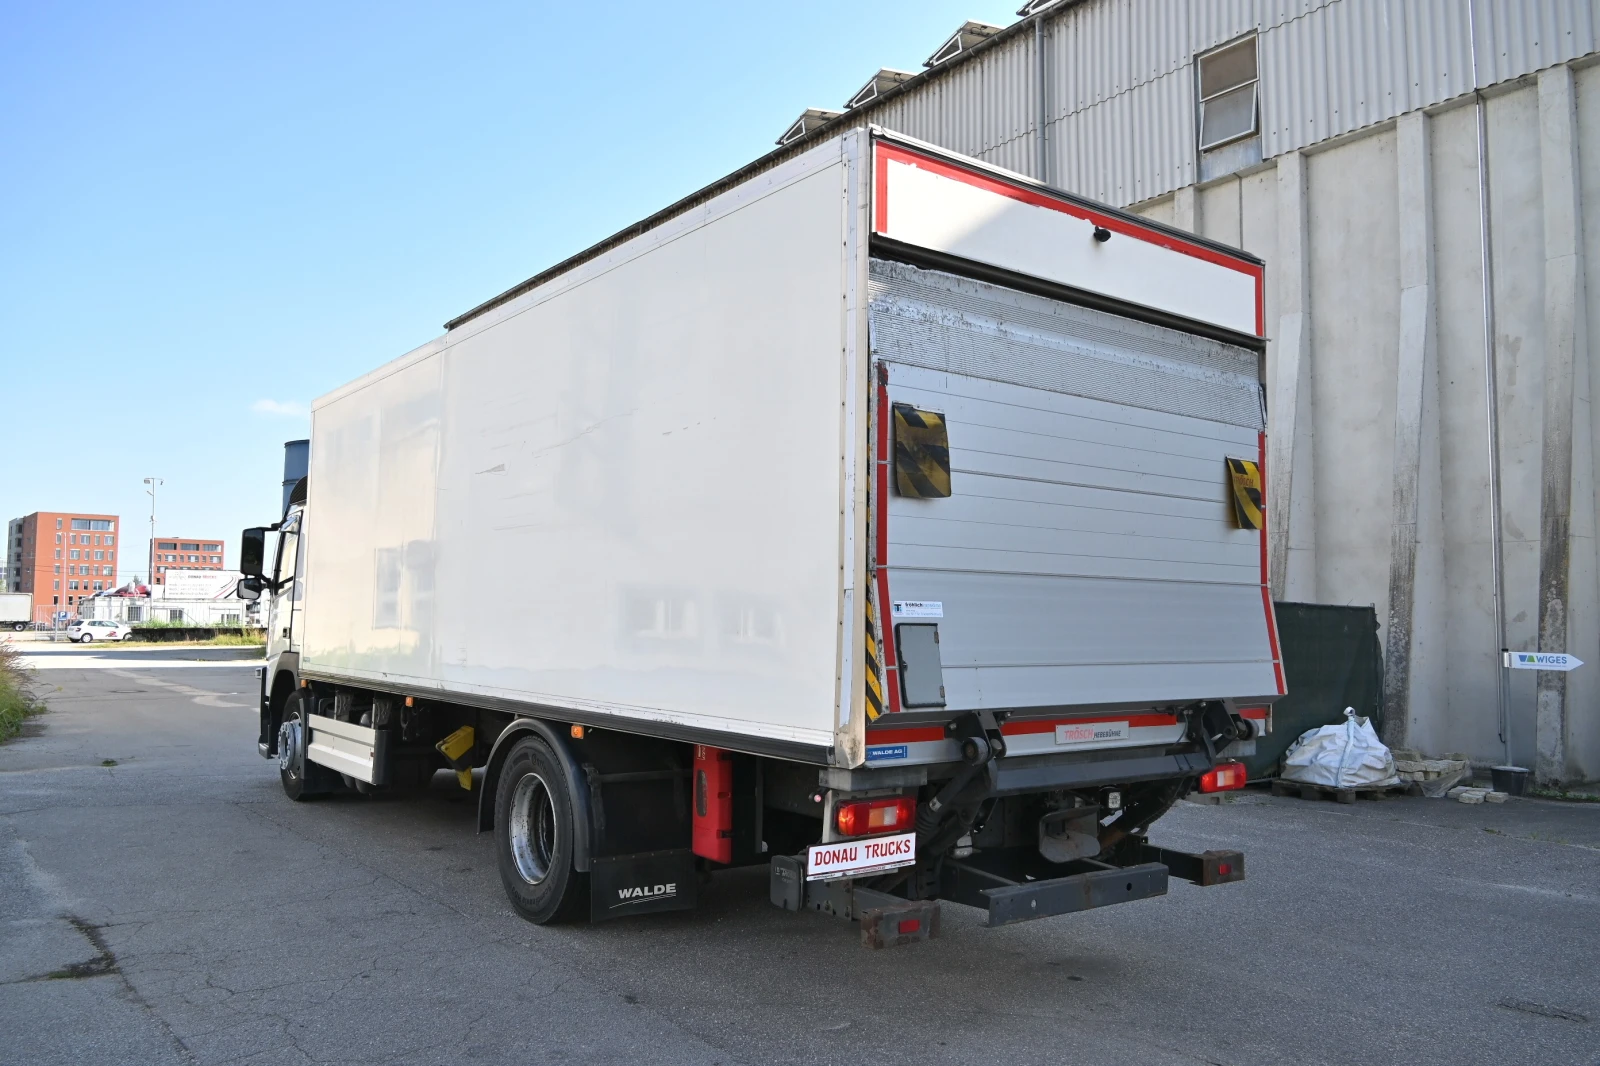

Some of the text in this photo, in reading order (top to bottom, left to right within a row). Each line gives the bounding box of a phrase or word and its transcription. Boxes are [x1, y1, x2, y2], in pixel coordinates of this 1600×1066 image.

[1536, 655, 1567, 664] WIGES
[1064, 726, 1093, 741] TRÖSCH
[814, 839, 911, 867] DONAU TRUCKS
[618, 883, 677, 899] WALDE
